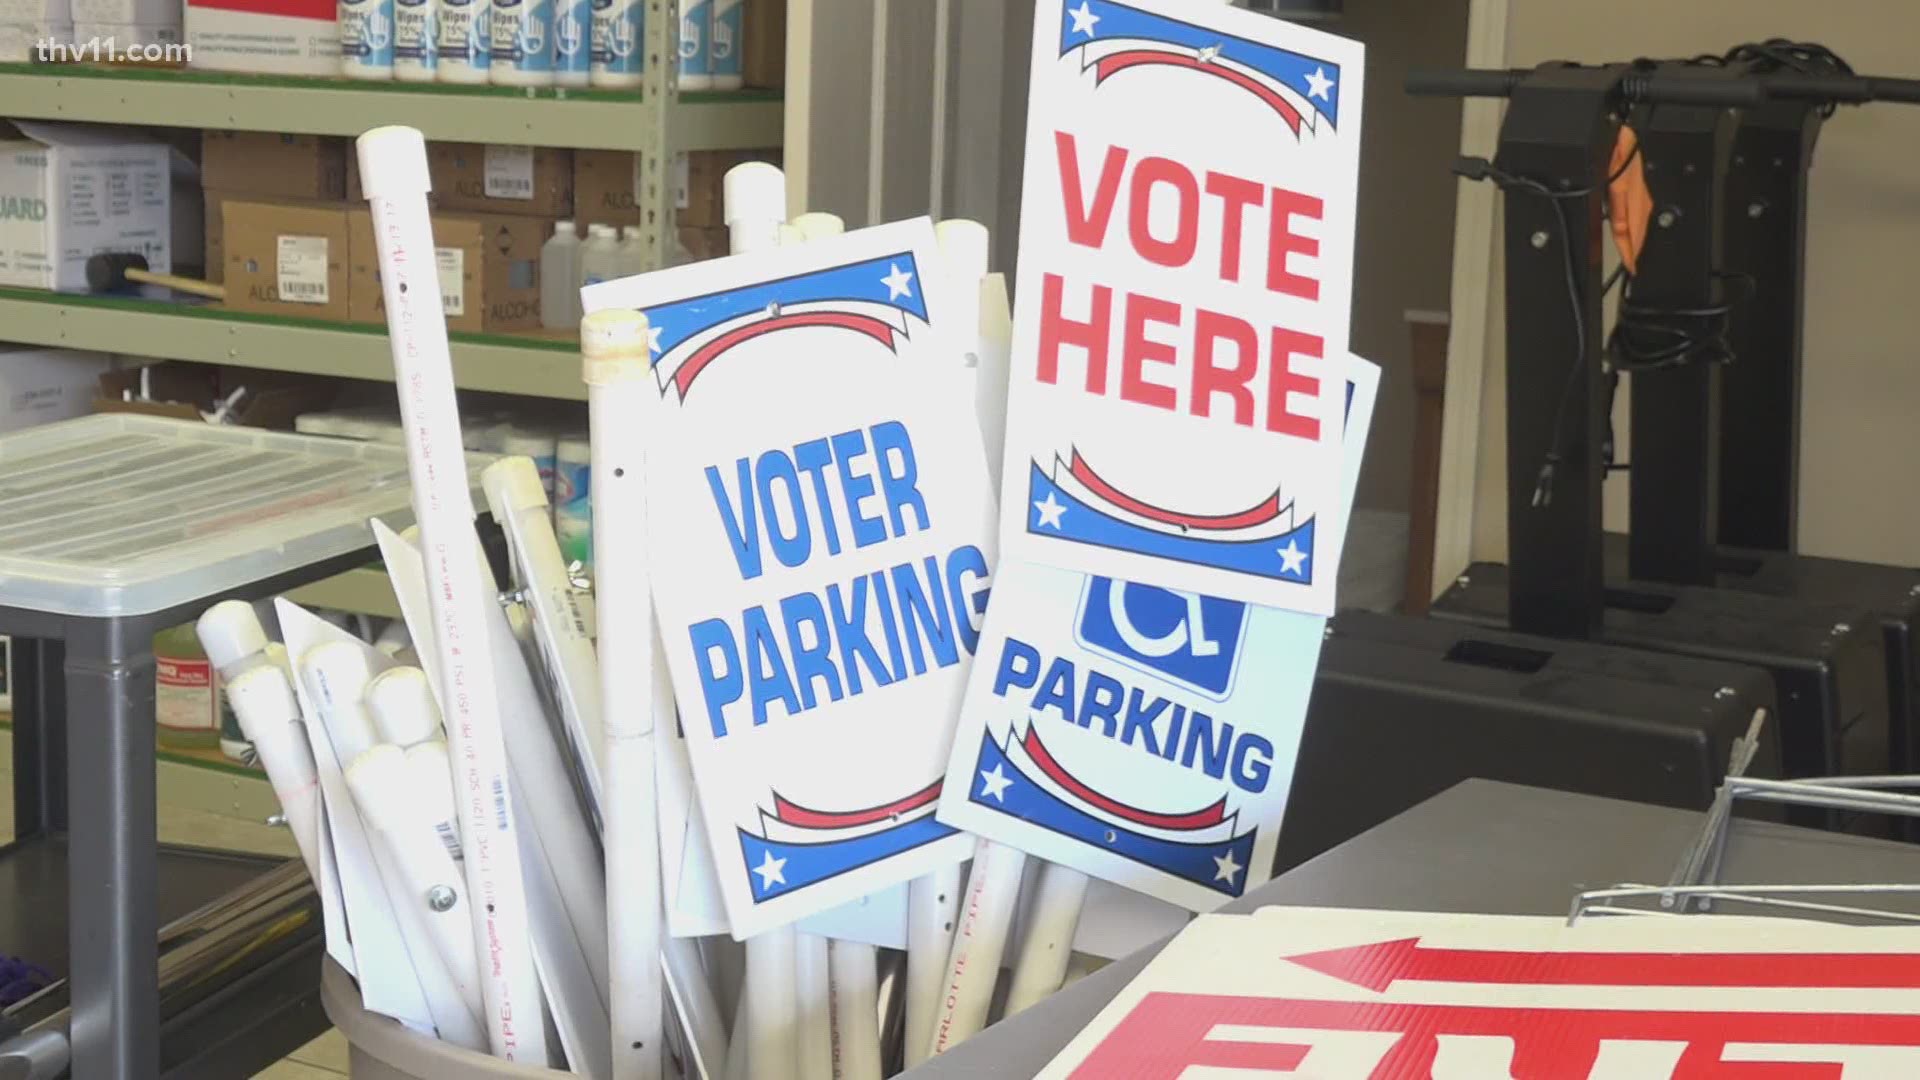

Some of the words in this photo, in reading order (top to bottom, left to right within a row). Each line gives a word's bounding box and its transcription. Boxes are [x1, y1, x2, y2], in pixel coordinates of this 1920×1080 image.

[1054, 130, 1324, 302] VOTE
[1036, 271, 1325, 442] HERE
[704, 420, 931, 580] VOTER
[688, 545, 993, 739] PARKING
[993, 636, 1274, 794] PARKING
